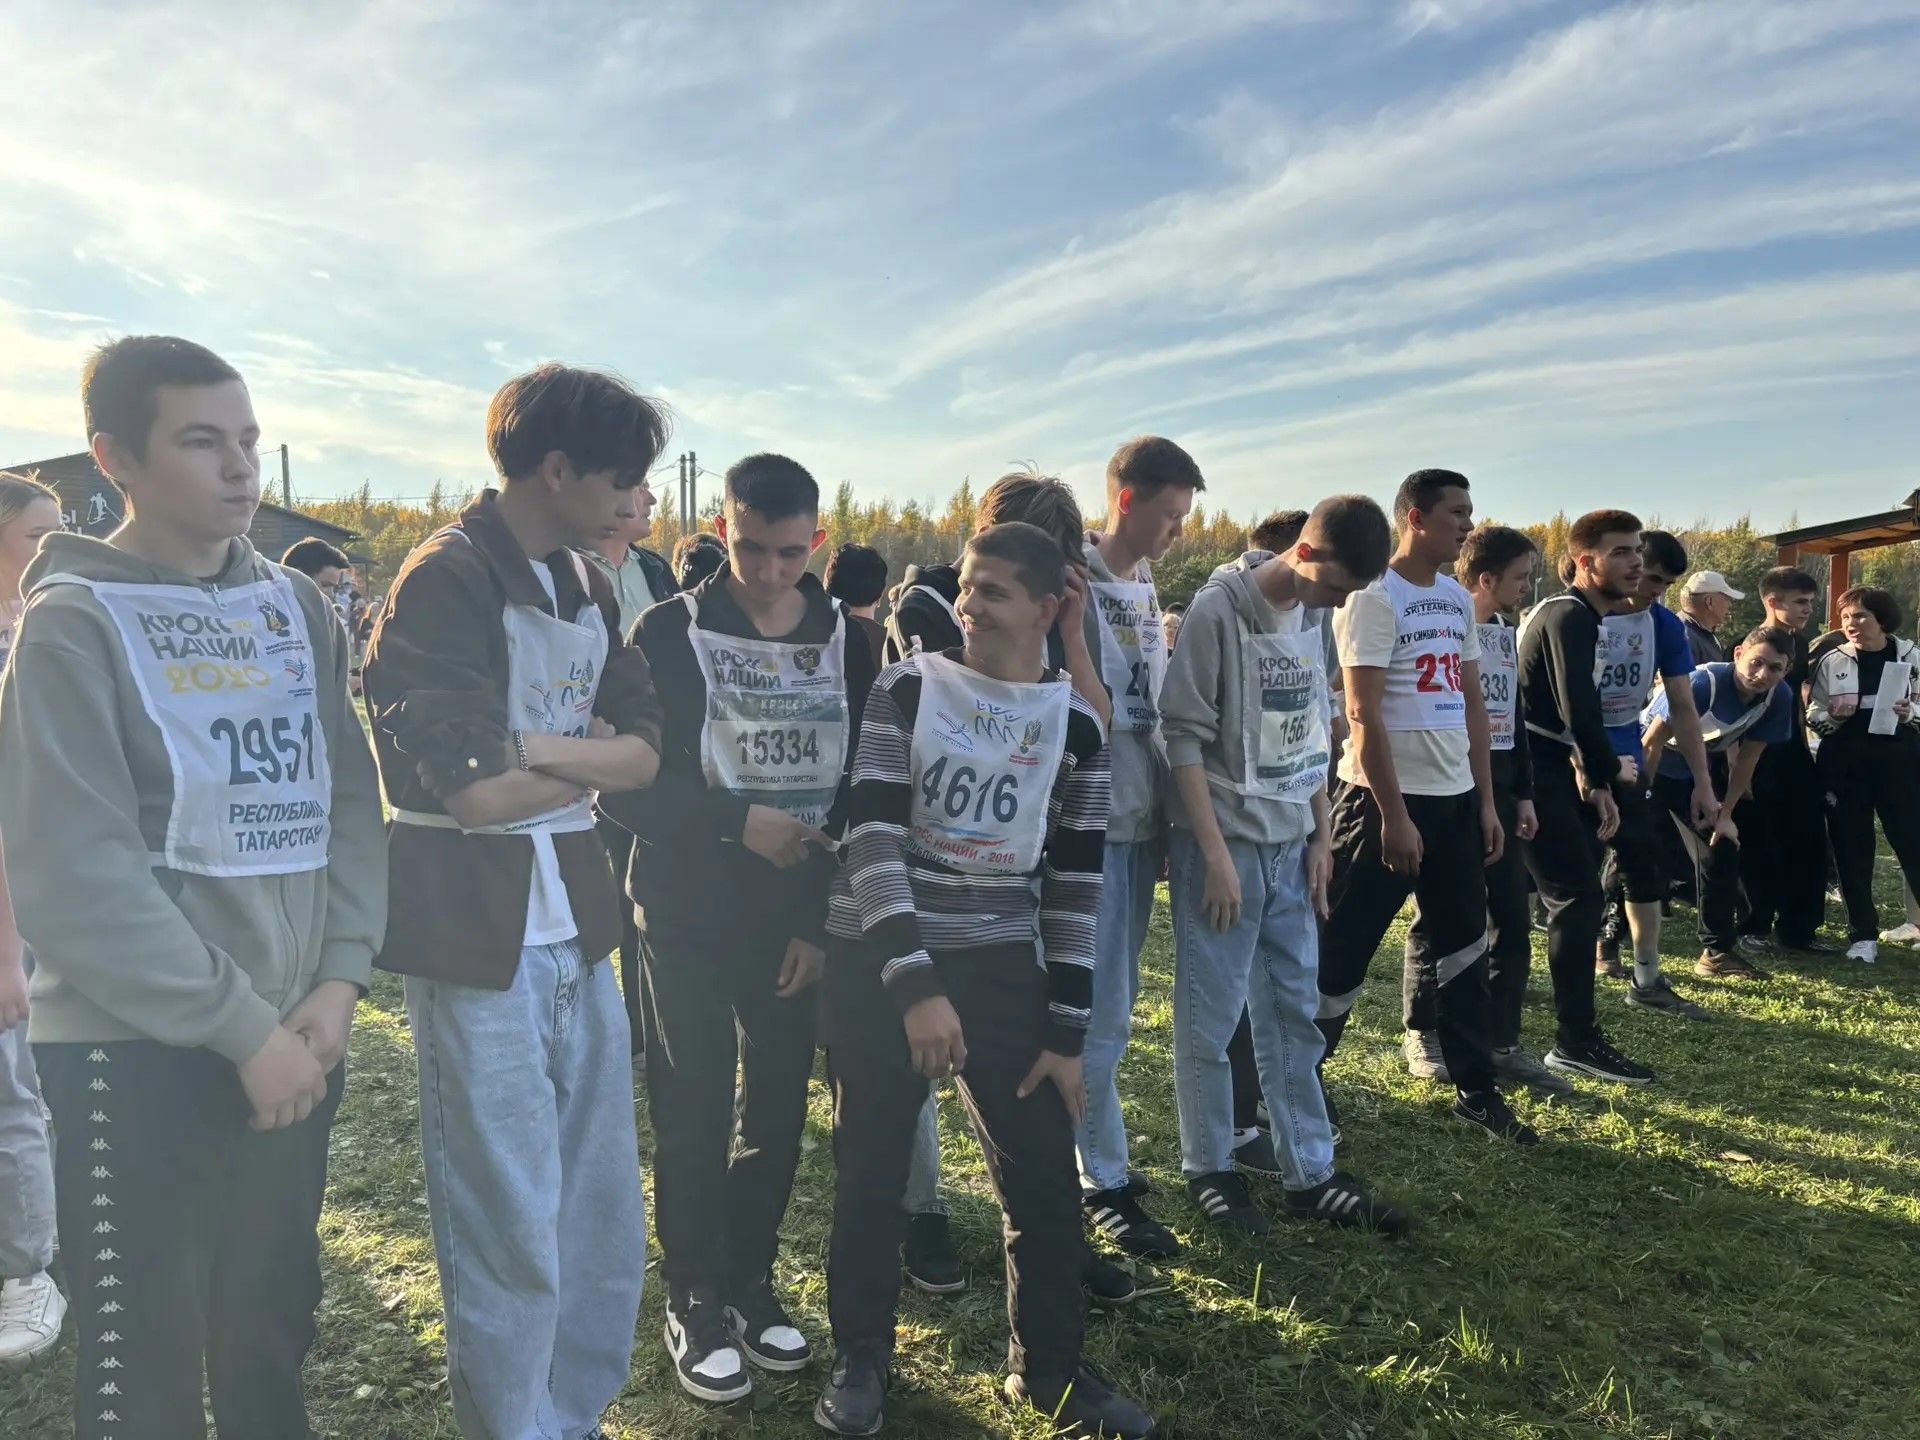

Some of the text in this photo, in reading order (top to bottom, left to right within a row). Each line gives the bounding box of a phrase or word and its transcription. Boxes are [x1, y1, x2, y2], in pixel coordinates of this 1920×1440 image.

[137, 612, 233, 635] КРОСС
[148, 635, 258, 661] НАЦИИ
[709, 648, 761, 670] КРОСС
[1257, 656, 1303, 672] КРОСС
[164, 661, 272, 695] 2020
[713, 667, 782, 689] НАЦИИ
[1259, 670, 1313, 688] НАЦИИ
[209, 711, 316, 787] 2951
[735, 728, 820, 766] 15334
[736, 774, 818, 785] РЕСПУБЛИКА ТАТАРСТАН
[921, 754, 1020, 824] 4616
[234, 824, 324, 853] ТАТАРСТАН
